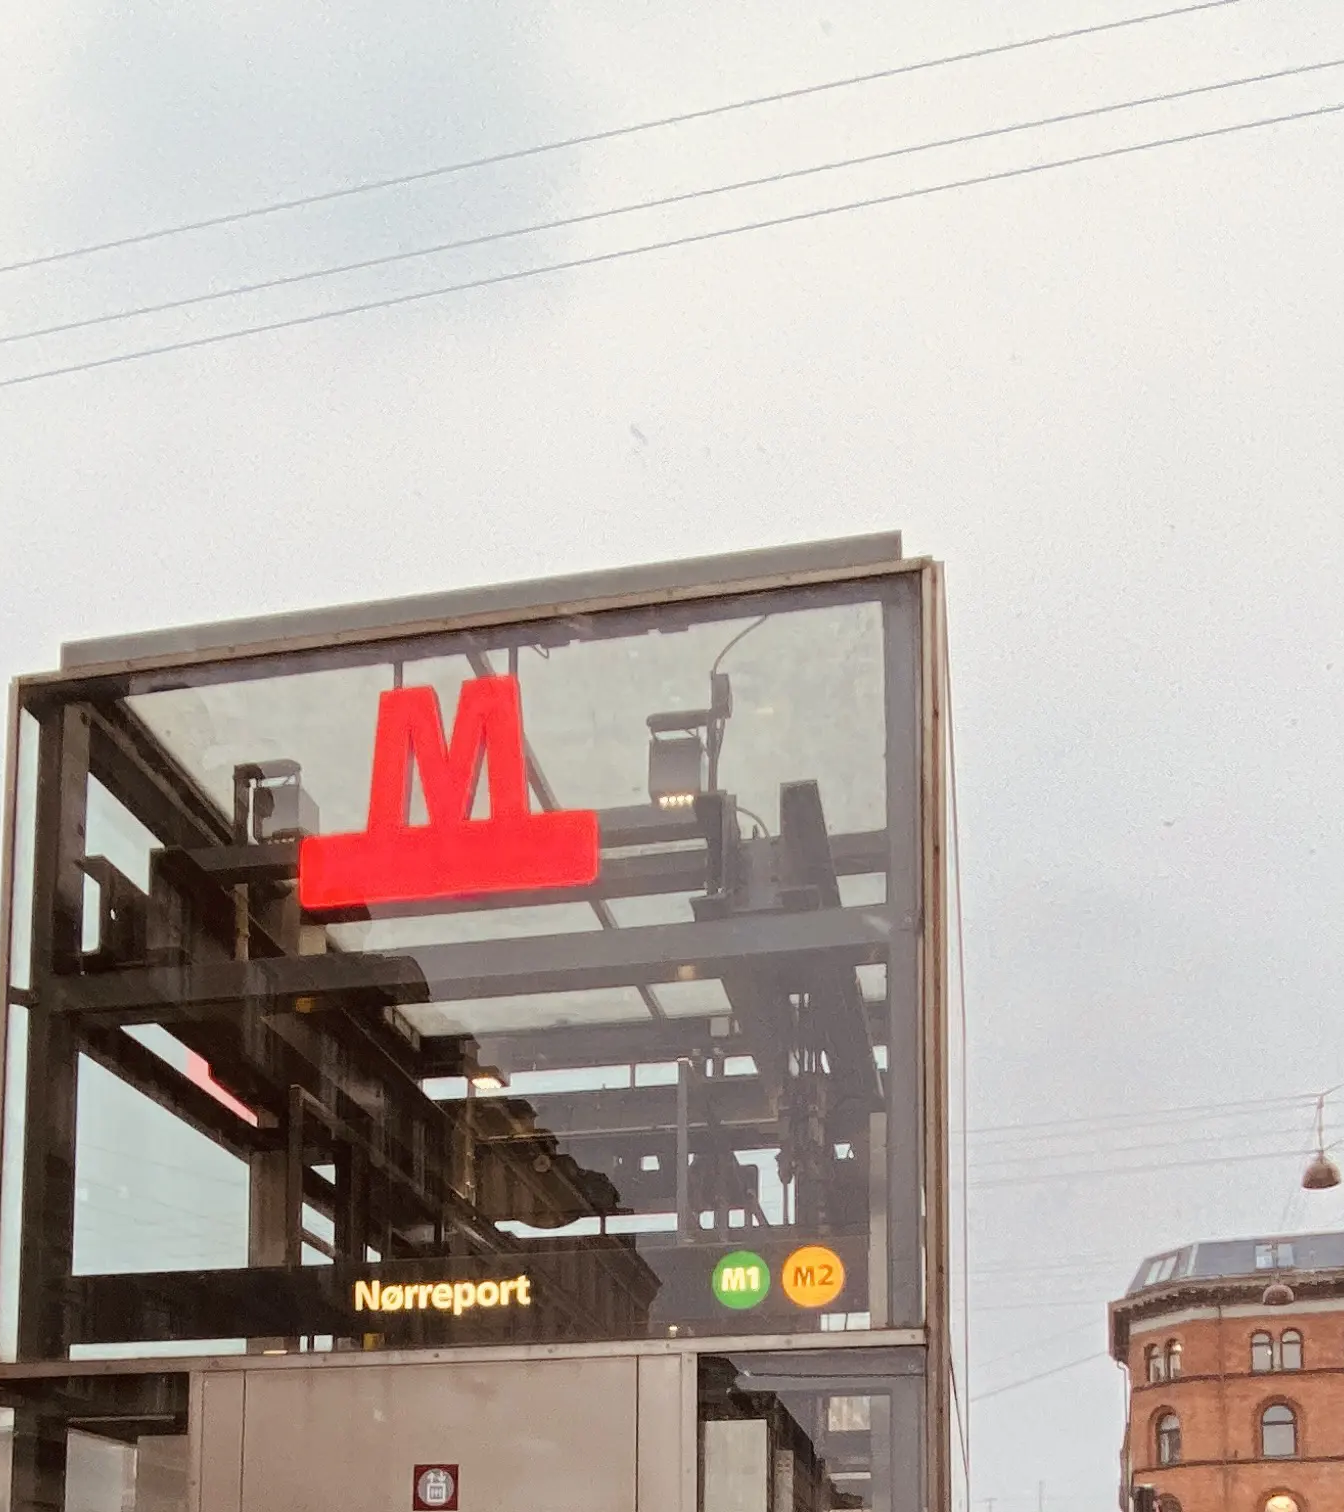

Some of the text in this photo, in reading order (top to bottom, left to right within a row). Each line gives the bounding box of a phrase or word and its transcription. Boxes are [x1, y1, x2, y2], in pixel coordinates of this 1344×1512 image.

[721, 1266, 761, 1291] M1
[793, 1264, 834, 1287] M2
[354, 1275, 531, 1316] Nørreport
